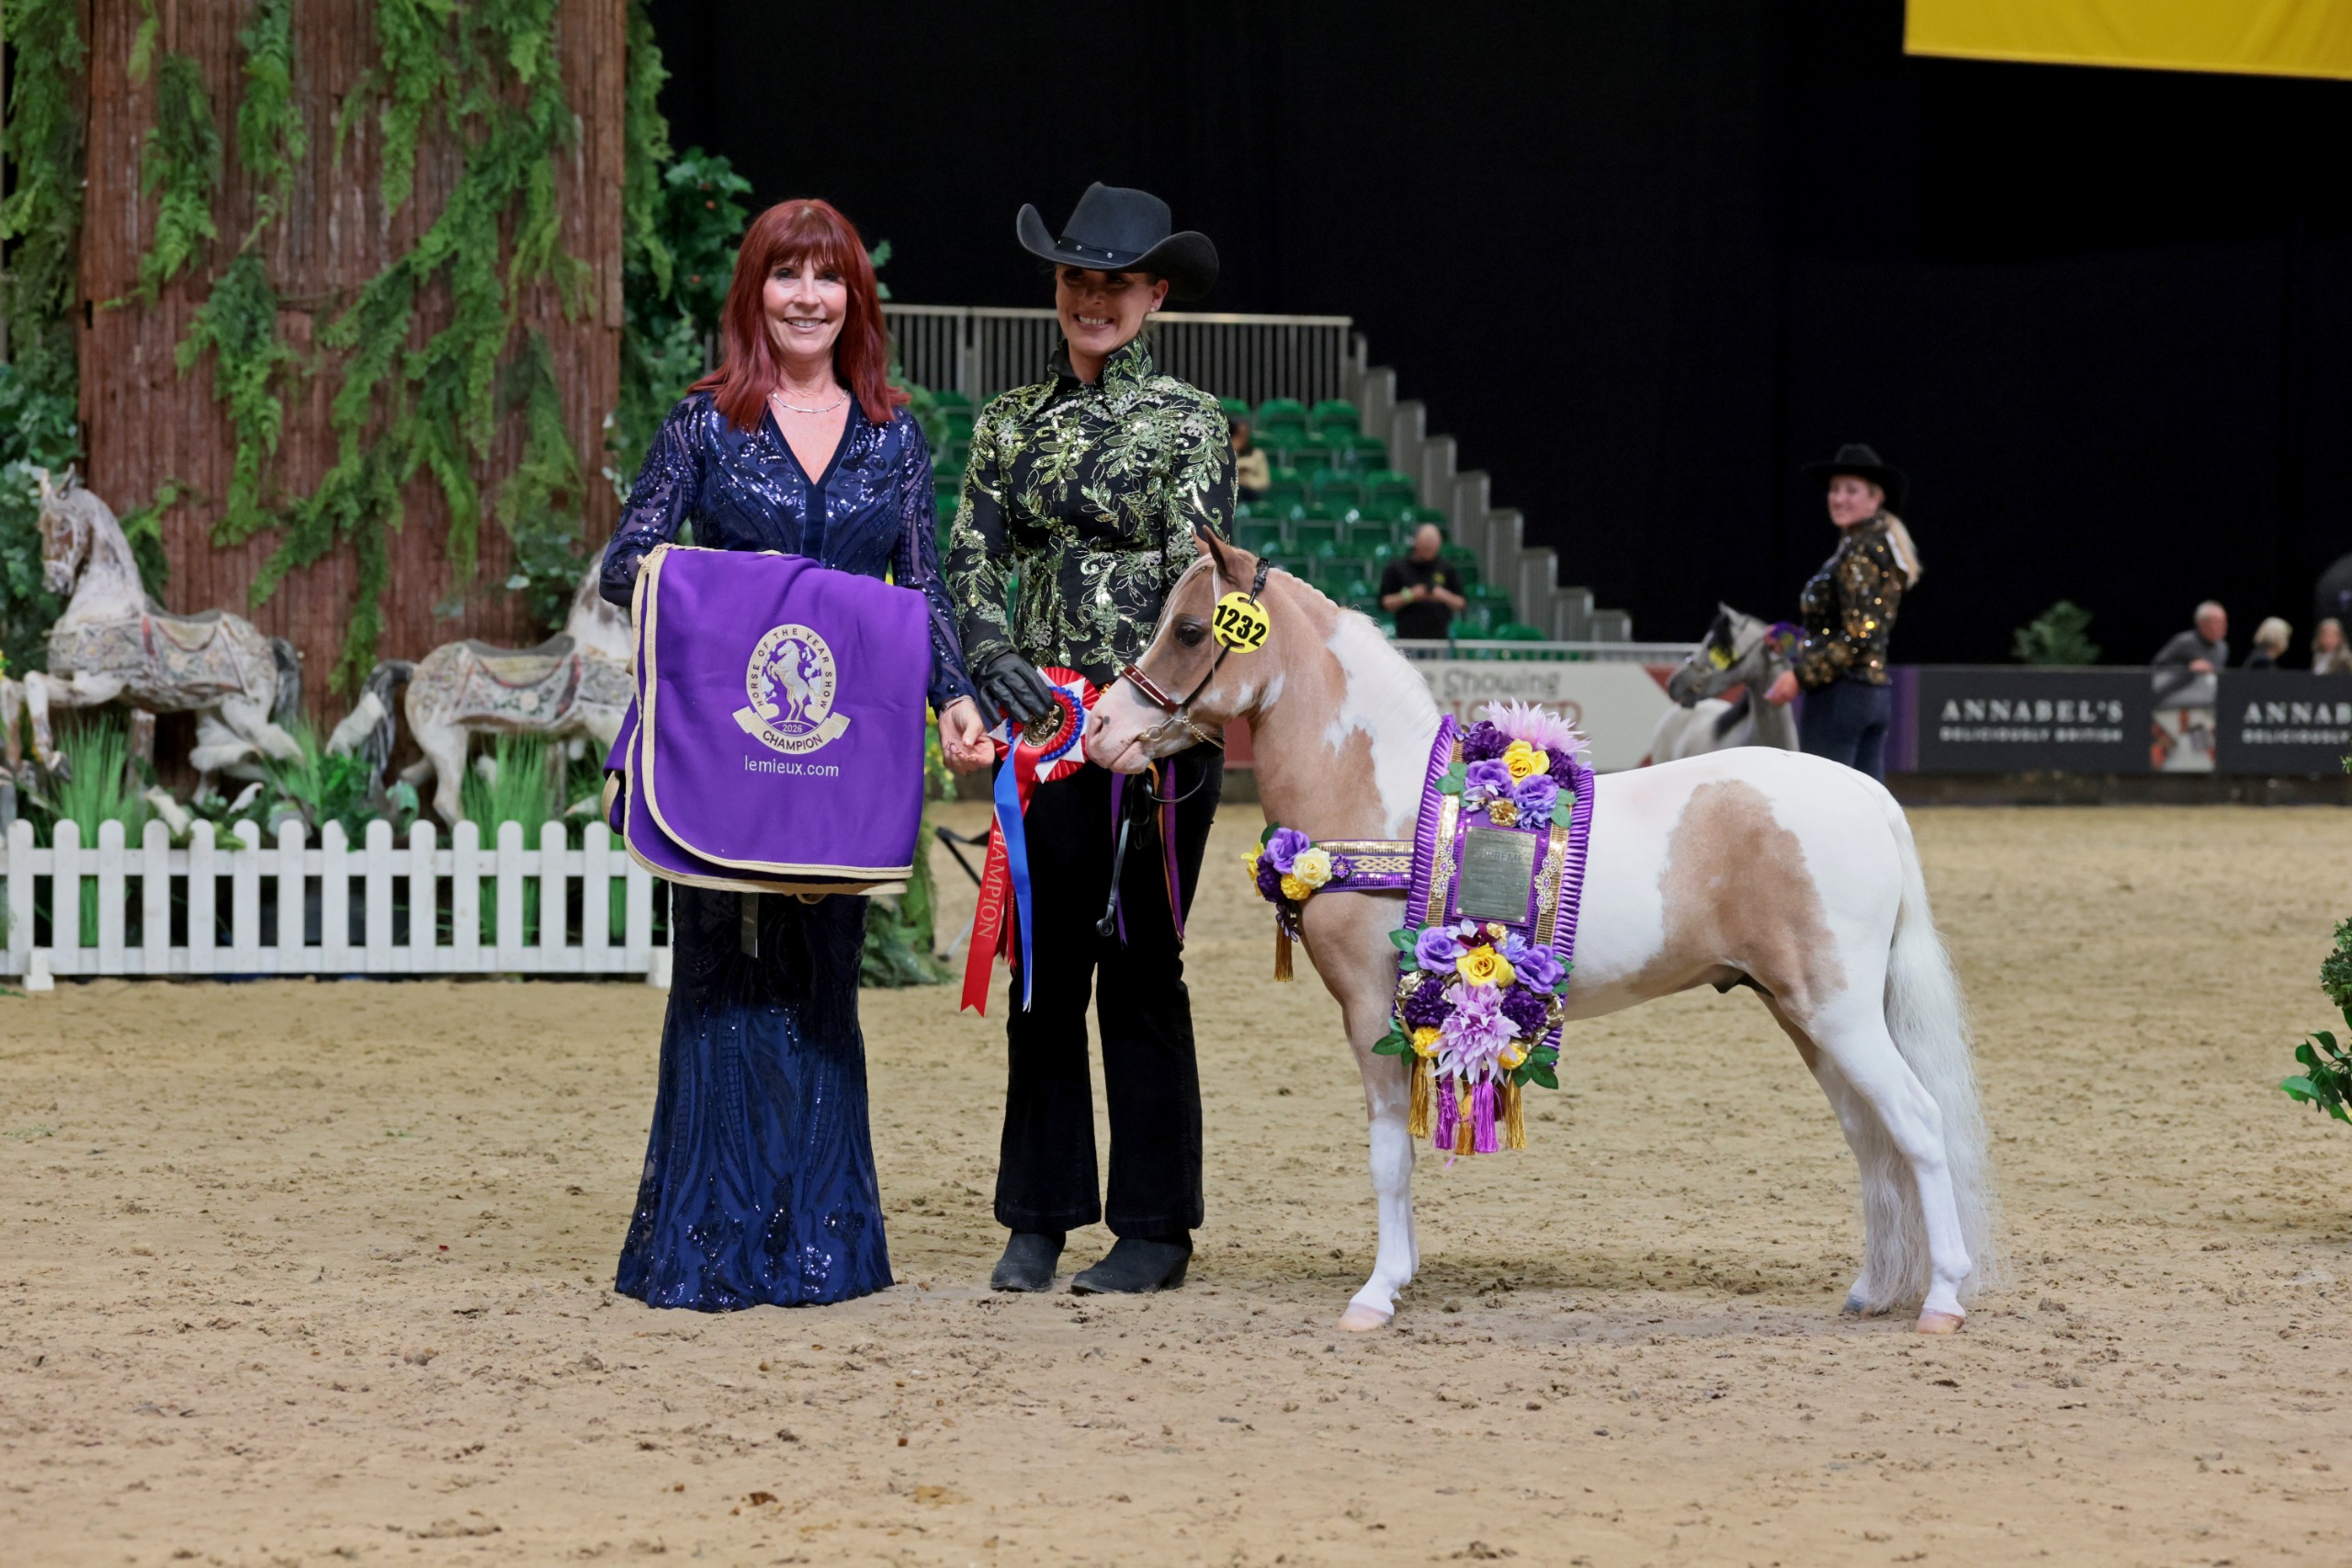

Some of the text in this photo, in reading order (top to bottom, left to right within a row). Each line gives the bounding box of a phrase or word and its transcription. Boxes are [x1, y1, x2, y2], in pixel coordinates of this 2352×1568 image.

[1214, 604, 1267, 648] 1232
[751, 627, 832, 709] HORSE OF THE YEAR SHOW
[1443, 668, 1561, 699] Showing
[1940, 699, 2123, 723] ANNABEL'S
[763, 730, 823, 751] CHAMPION
[782, 724, 803, 733] 2026
[1939, 726, 2123, 742] DELICIOUSLY BRITISH
[744, 755, 839, 777] lemieux.com
[976, 829, 1007, 940] HAMPION
